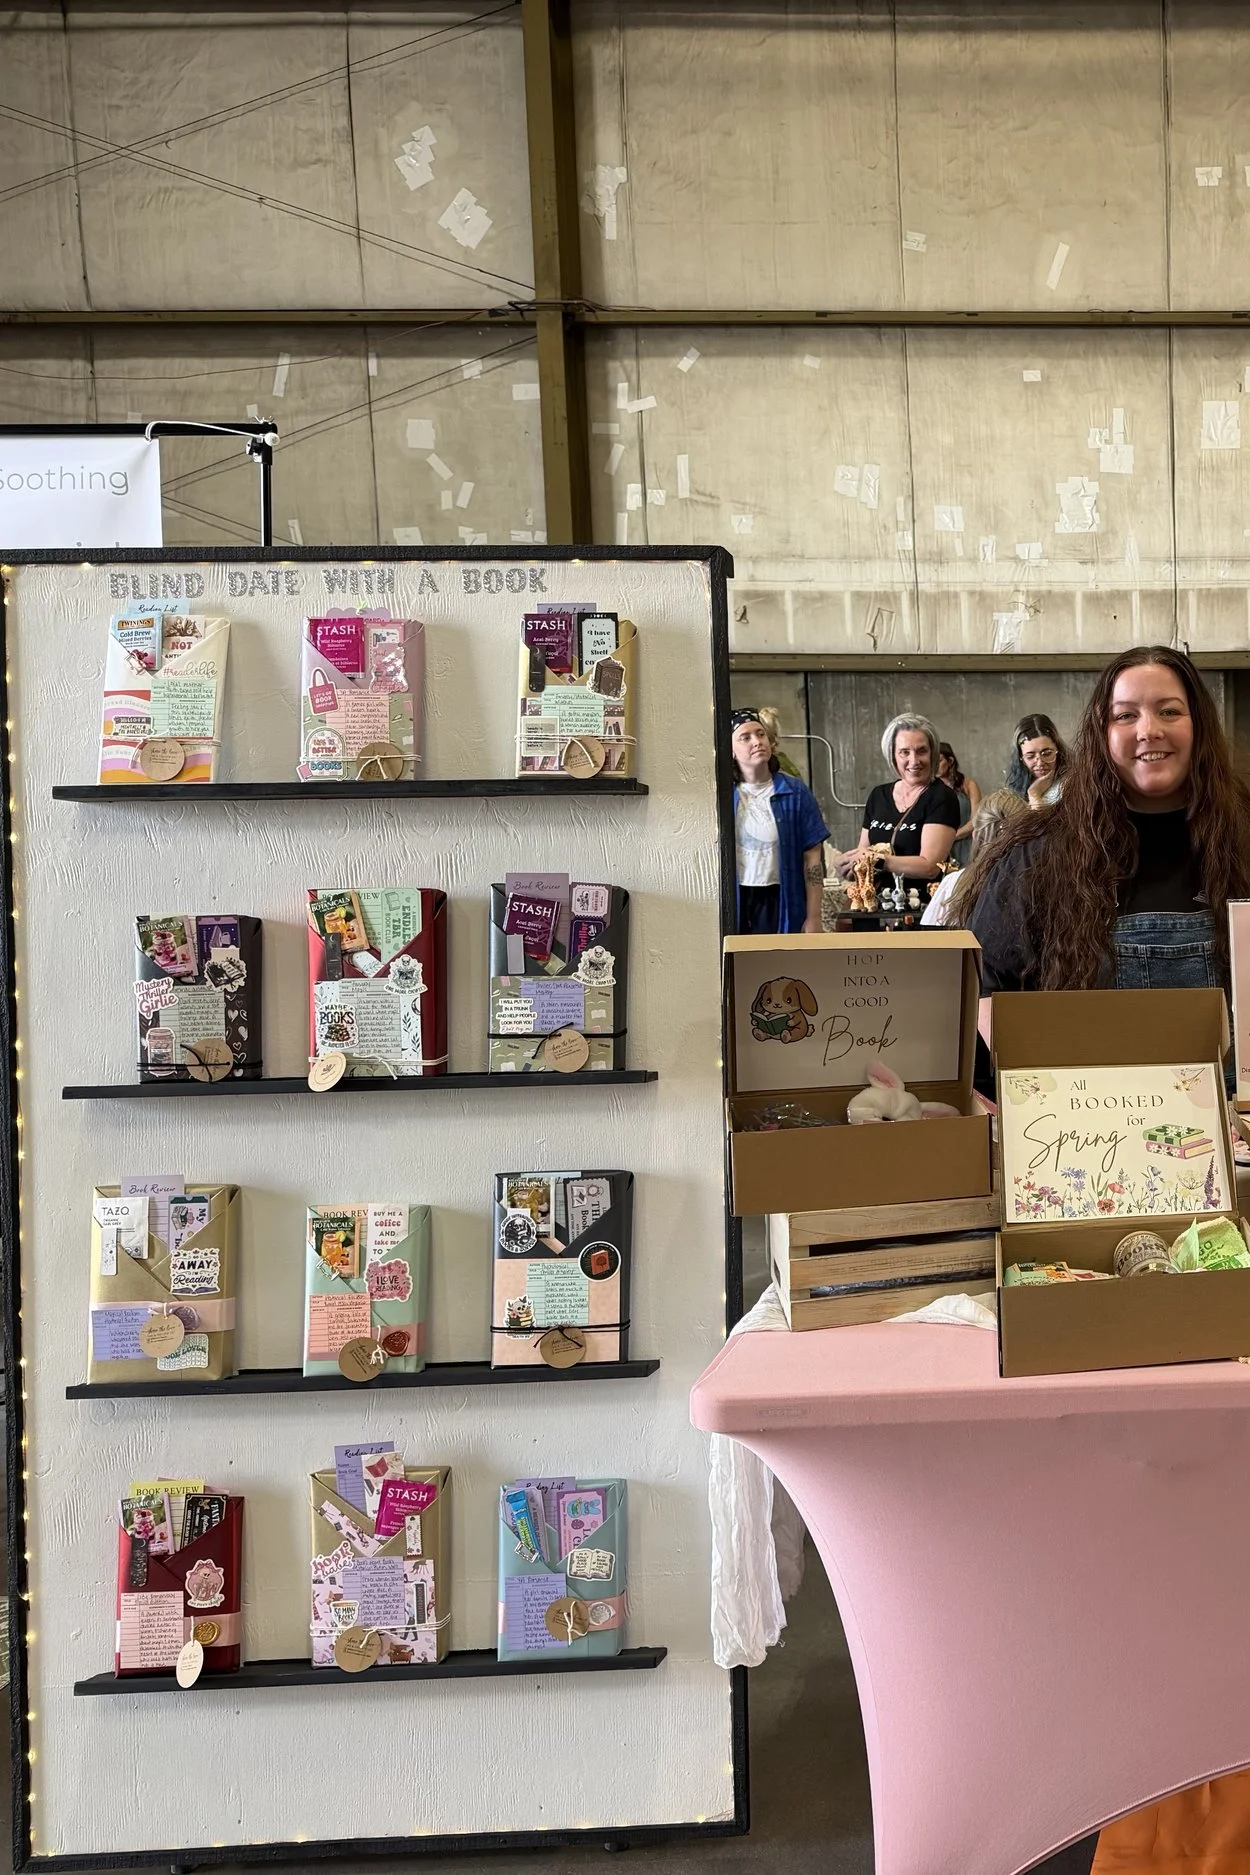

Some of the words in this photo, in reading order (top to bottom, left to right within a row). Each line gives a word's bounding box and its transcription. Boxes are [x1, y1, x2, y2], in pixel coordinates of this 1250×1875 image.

[109, 572, 205, 600] BLIND
[228, 569, 299, 597] DATE
[321, 567, 395, 595] WITH
[418, 569, 439, 594] A
[462, 567, 548, 595] BOOK
[121, 619, 152, 627] TWININGS
[527, 621, 565, 630] STASH
[317, 625, 356, 635] STASH
[171, 642, 192, 650] NOT
[163, 661, 218, 678] #readerlife
[310, 761, 342, 770] BOOKS
[513, 882, 532, 890] Book
[536, 882, 560, 890] Review
[312, 897, 351, 912] BOTANICALS
[512, 902, 552, 918] STASH
[140, 921, 183, 932] BOTANICALS
[392, 918, 400, 938] TBR
[847, 955, 885, 965] HOP
[135, 978, 172, 991] Mystery
[844, 976, 877, 986] INTO
[879, 975, 890, 985] A
[139, 988, 169, 1001] Thriller
[140, 995, 177, 1012] Girlie
[844, 997, 889, 1008] GOOD
[320, 1012, 354, 1024] BOOKS
[821, 1015, 898, 1066] Book
[1070, 1080, 1087, 1091] All
[1070, 1095, 1164, 1110] BOOKED
[1126, 1115, 1146, 1126] for
[1023, 1113, 1128, 1173] Spring
[129, 1184, 147, 1194] Book
[150, 1184, 176, 1194] Review
[101, 1206, 130, 1216] TAZO
[196, 1208, 206, 1224] My
[581, 1210, 589, 1230] Book
[1118, 1242, 1167, 1270] Books
[178, 1260, 212, 1270] AWAY
[173, 1274, 213, 1285] Reading
[376, 1276, 379, 1284] I
[380, 1276, 399, 1285] LOVE
[376, 1284, 401, 1292] READING
[165, 1486, 200, 1495] REVIEW
[551, 1482, 565, 1490] List
[387, 1488, 428, 1502] STASH
[123, 1500, 162, 1510] BOTANICALS
[342, 1607, 355, 1615] MANY
